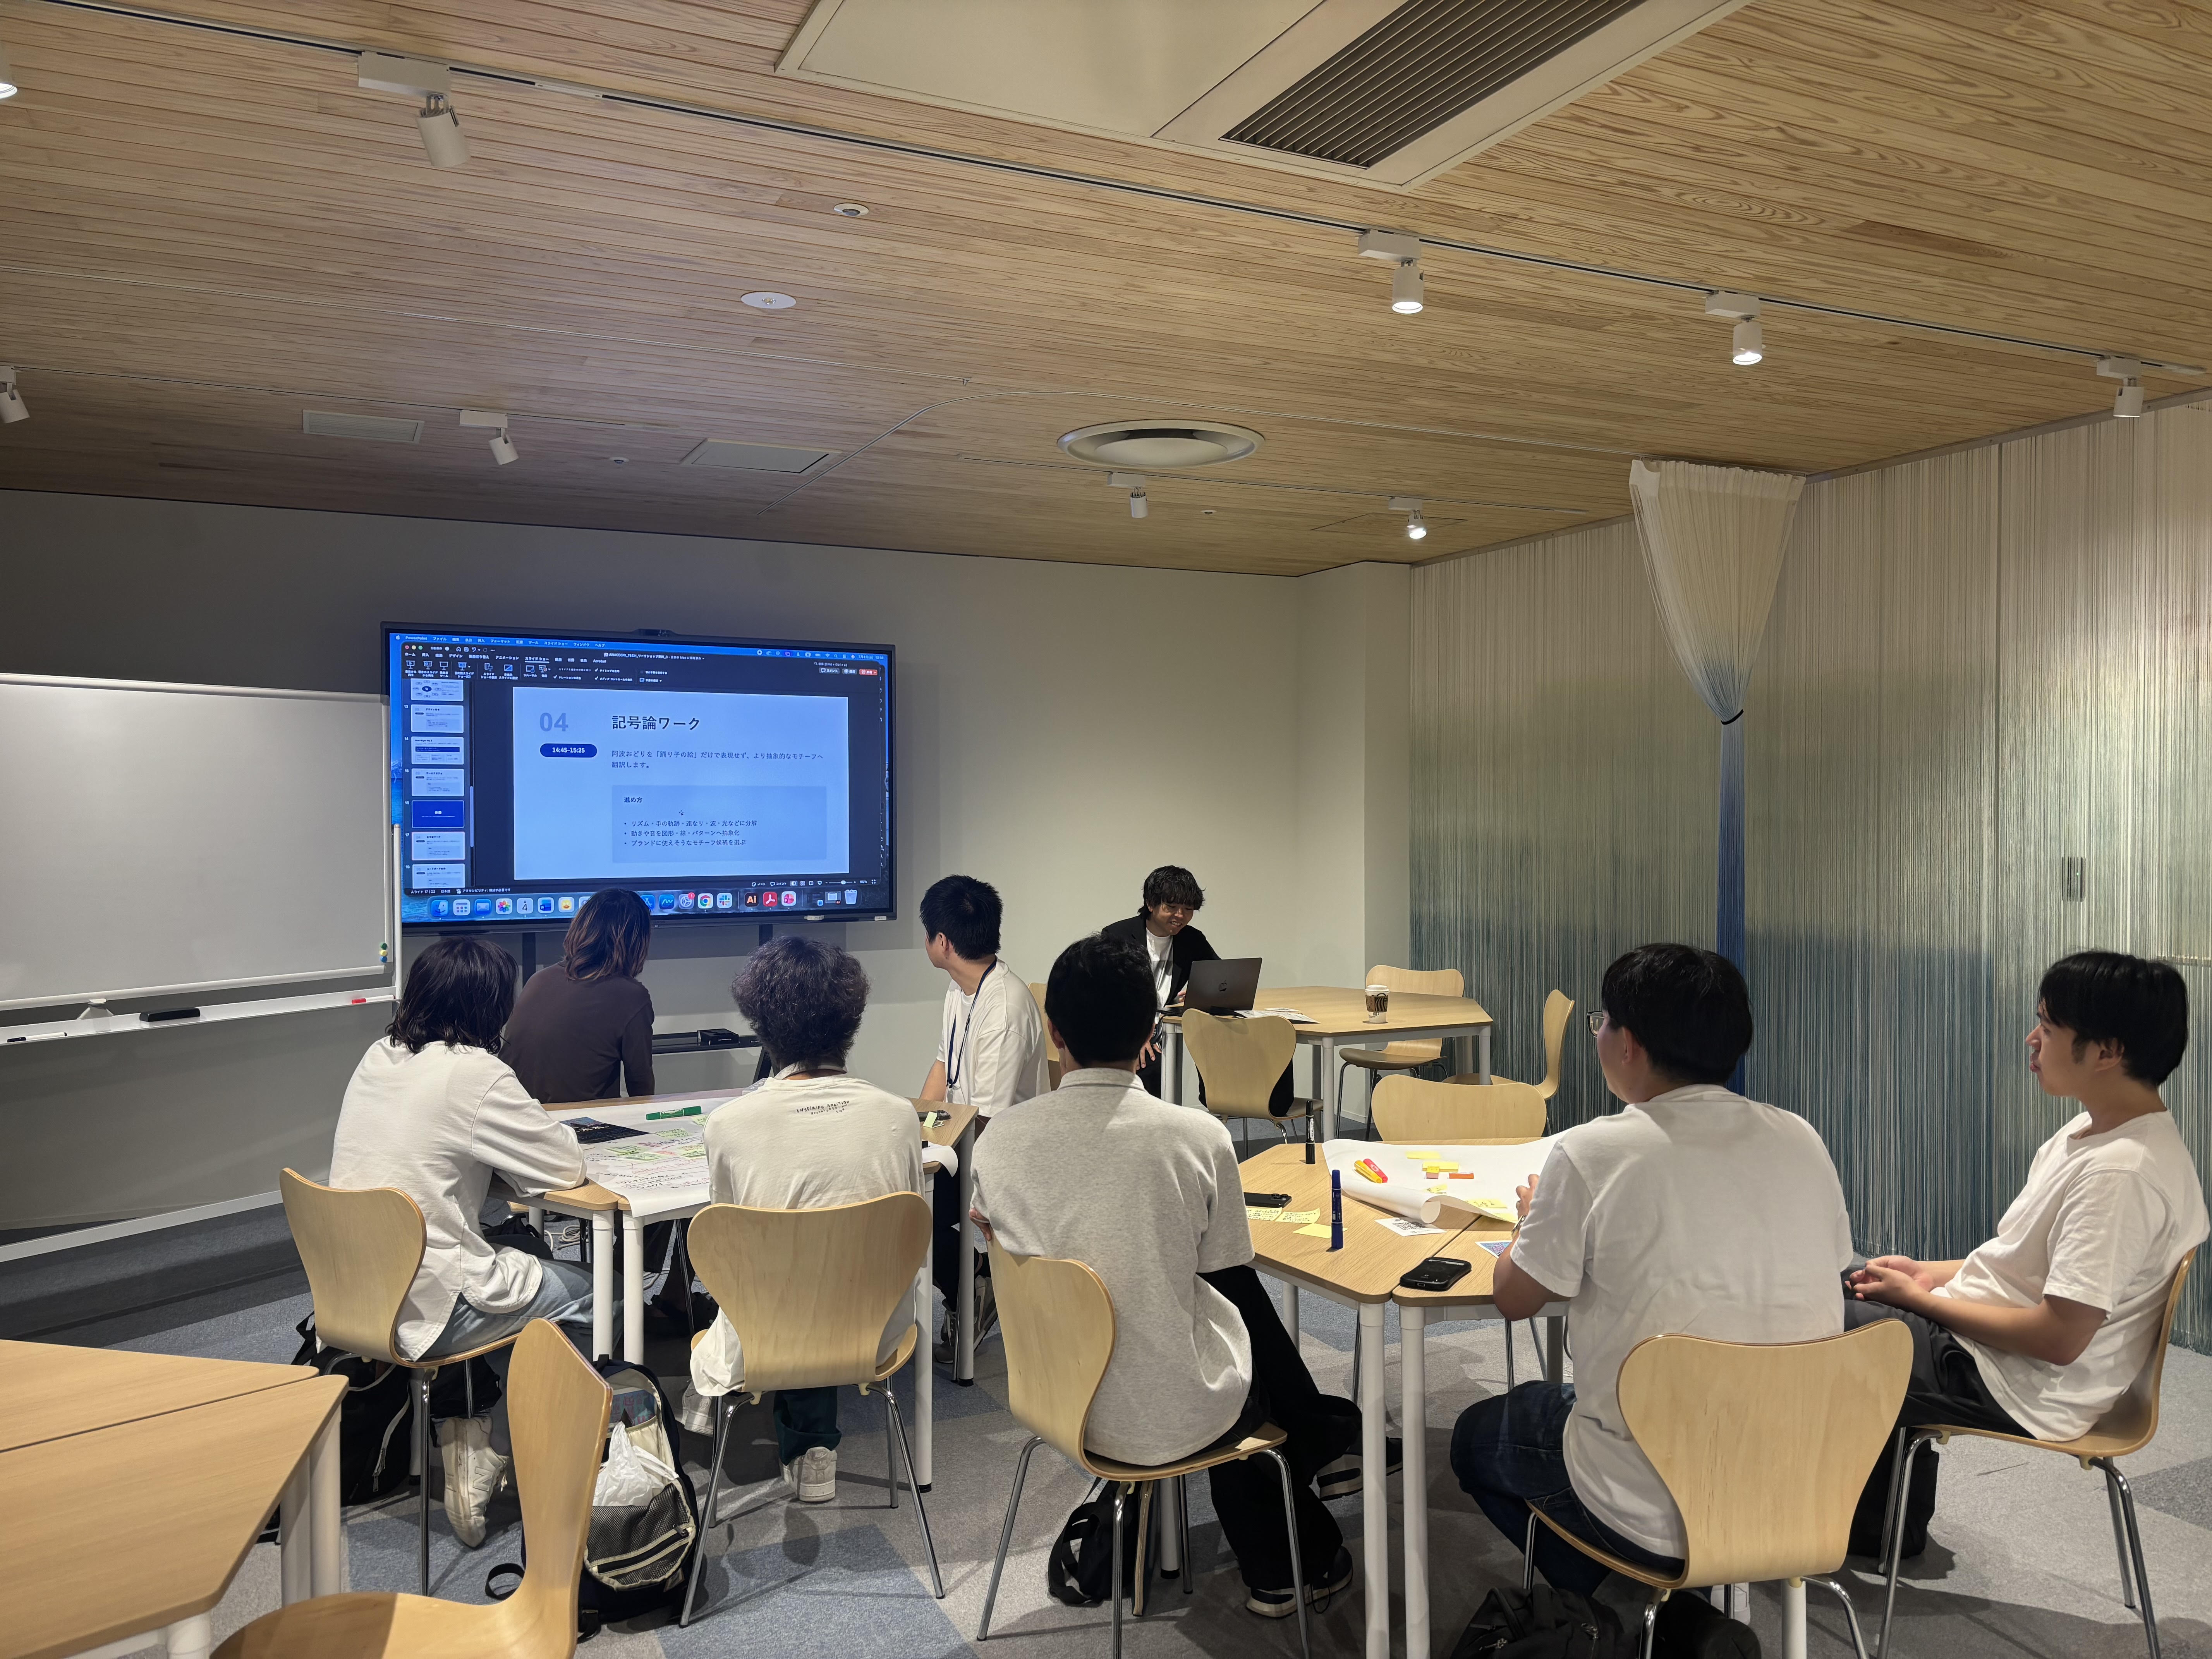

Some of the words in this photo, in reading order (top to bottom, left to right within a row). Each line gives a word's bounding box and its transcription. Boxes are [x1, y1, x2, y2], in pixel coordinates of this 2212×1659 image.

[539, 713, 568, 732] 04
[612, 716, 700, 730] 記号論ワーク
[611, 750, 823, 759] 阿波おどりを「踊り子の絵」だけで表現せず、より抽象的なモチーフへ
